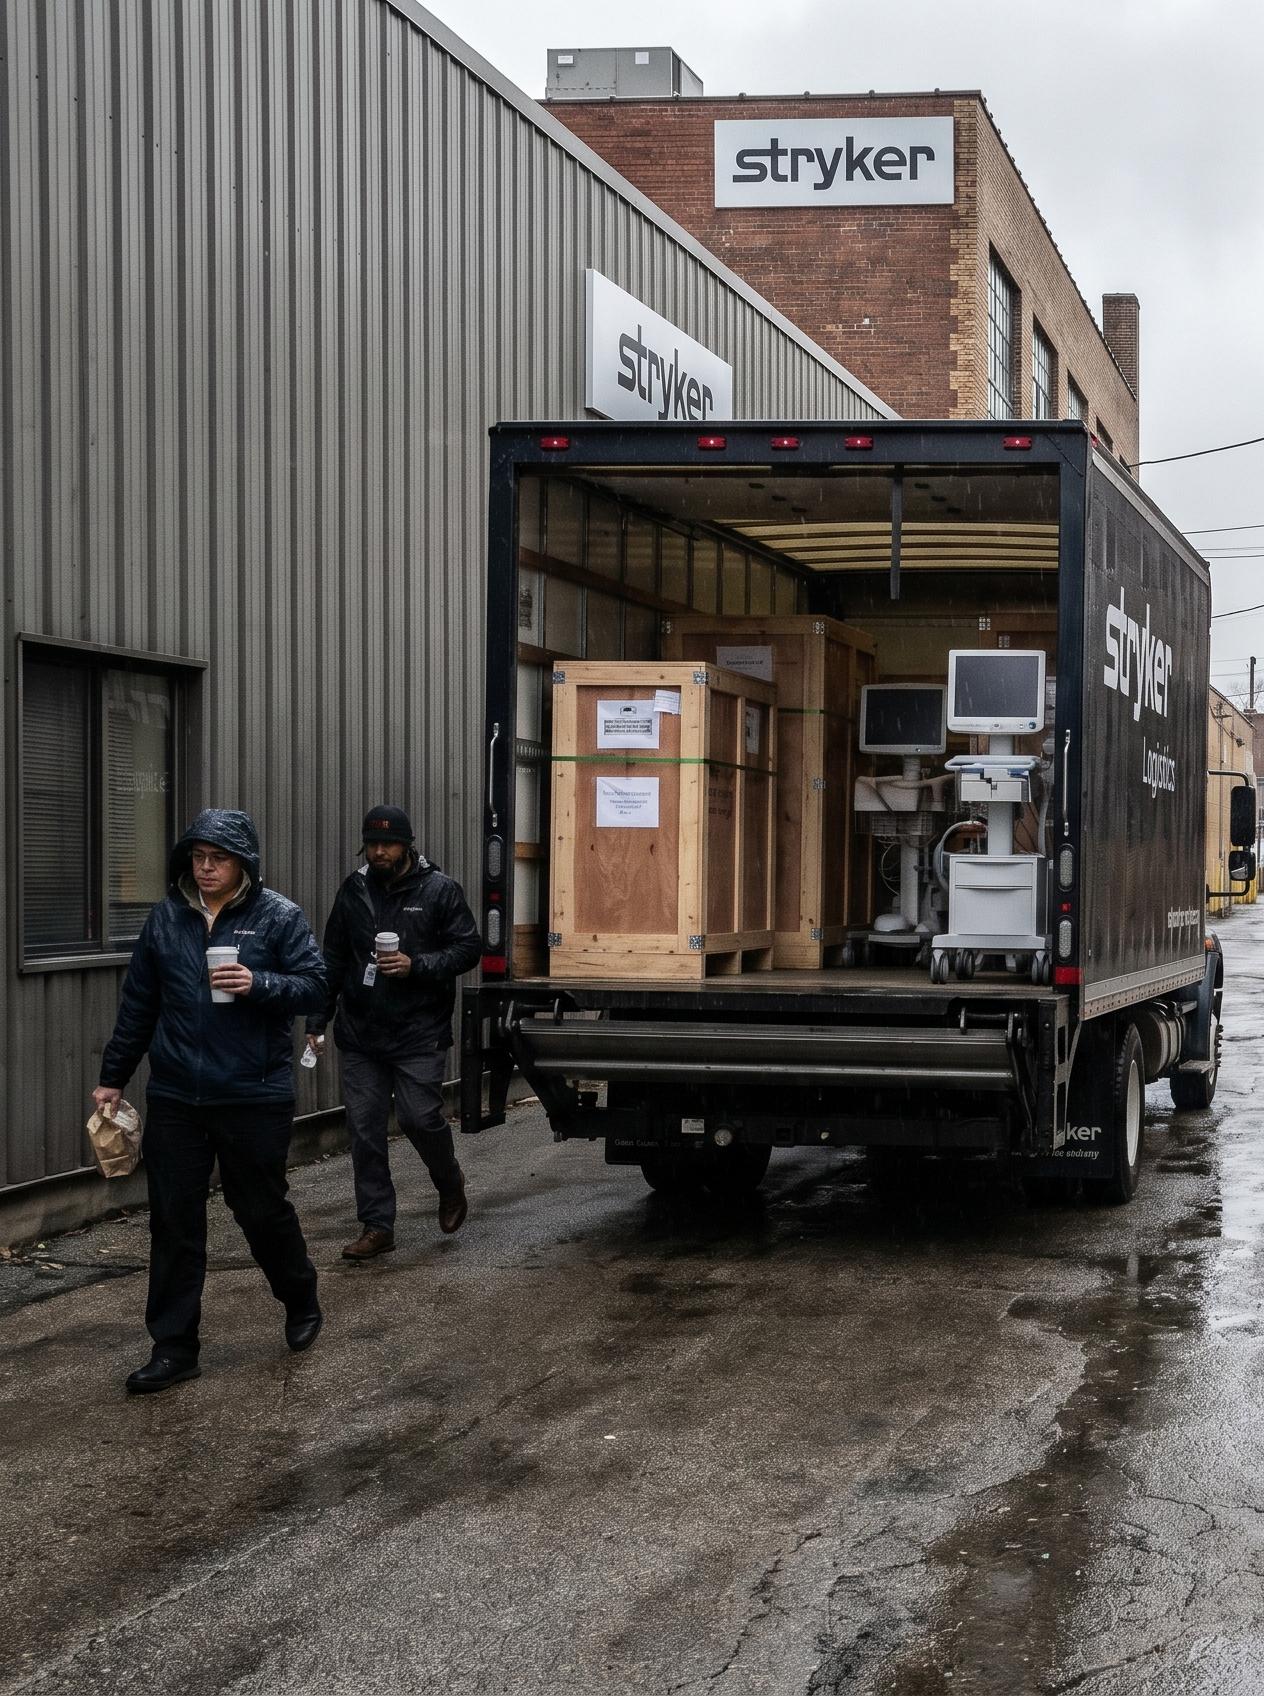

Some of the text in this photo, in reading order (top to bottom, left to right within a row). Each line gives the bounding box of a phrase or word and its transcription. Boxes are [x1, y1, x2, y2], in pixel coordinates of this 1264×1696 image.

[732, 136, 936, 191] stryker
[617, 323, 714, 421] stryker
[1103, 586, 1172, 722] stryker
[1142, 736, 1175, 799] Logistics
